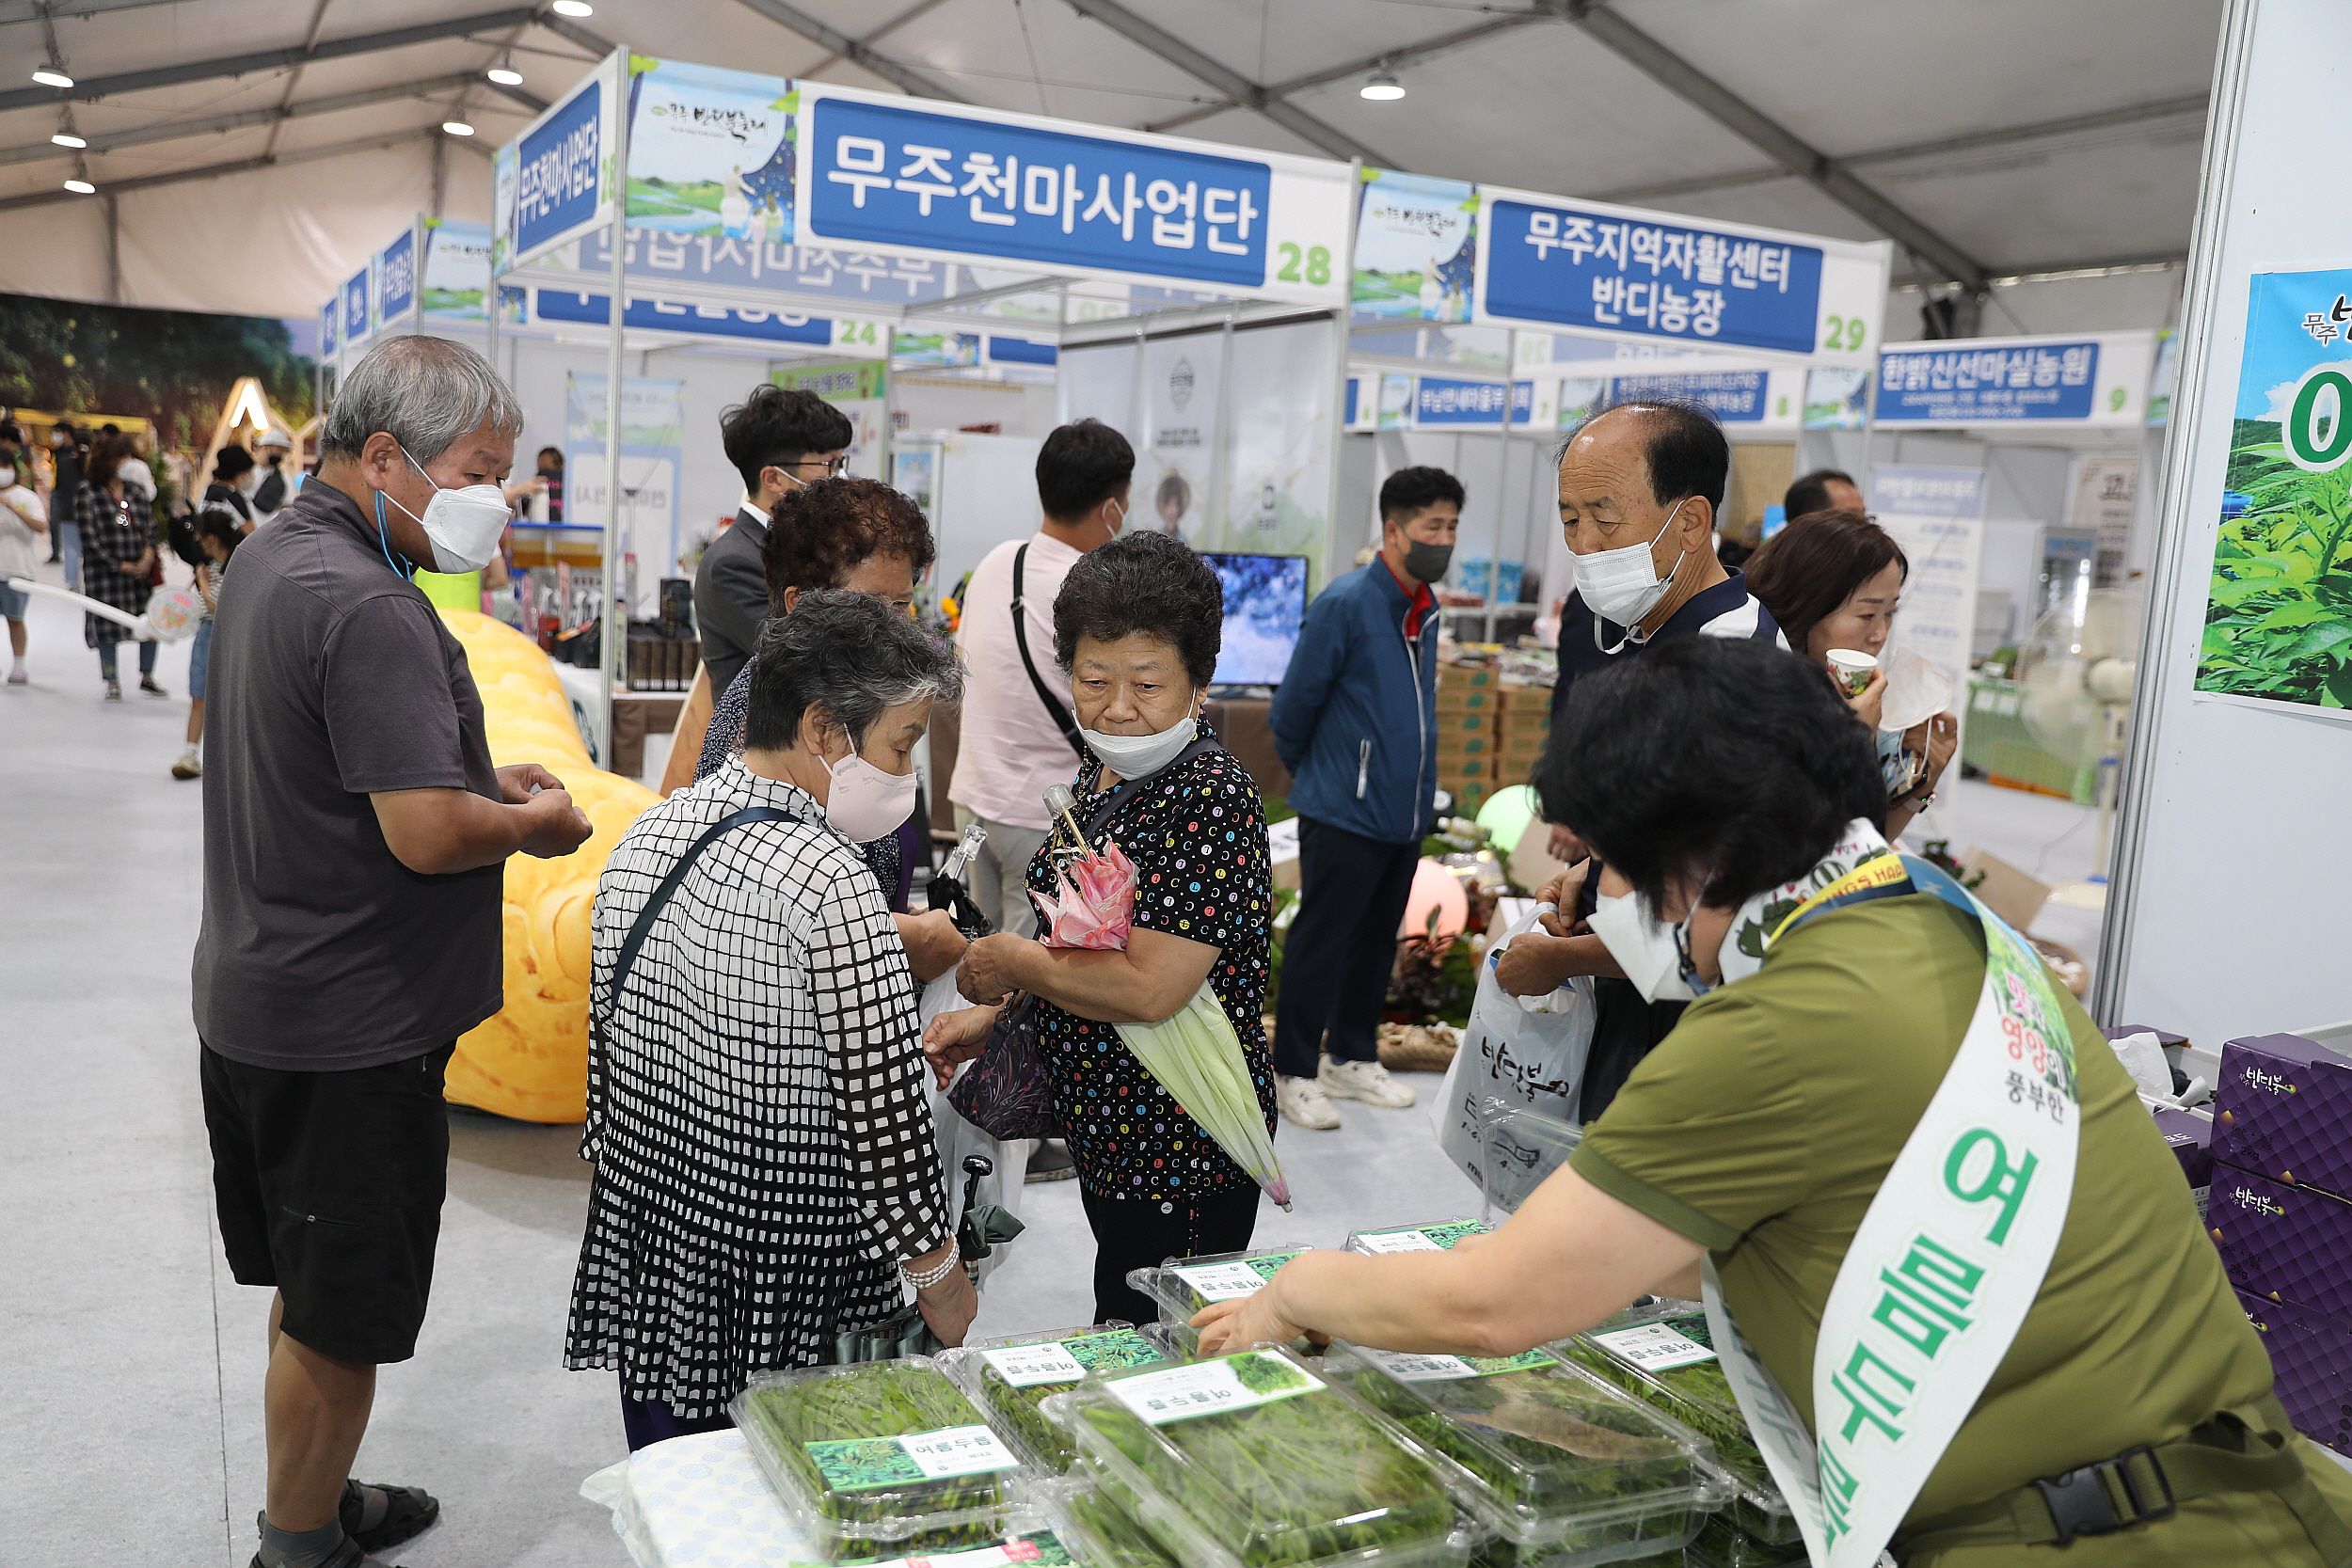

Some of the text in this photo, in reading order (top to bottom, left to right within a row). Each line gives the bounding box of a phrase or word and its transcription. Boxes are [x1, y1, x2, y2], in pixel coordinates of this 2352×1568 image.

[519, 114, 598, 228] 무주천마사업단
[826, 134, 1259, 257] 무주천마사업단
[1278, 242, 1332, 286] 28
[1524, 211, 1791, 293] 무주지역자활센터
[1592, 275, 1726, 338] 반디농장
[839, 320, 877, 346] 24
[1823, 315, 1866, 352] 29
[2303, 314, 2337, 344] 무주
[2110, 387, 2126, 412] 9
[2001, 1016, 2067, 1089] 영양이
[1482, 1037, 1562, 1101] 반딧불
[2247, 1067, 2293, 1095] 반딧불
[2005, 1069, 2064, 1125] 풍부한
[2240, 1147, 2260, 1161] 2kg
[2235, 1186, 2280, 1216] 반딧불
[1200, 1279, 1263, 1291] 여름두릅
[2229, 1264, 2249, 1280] 2kg
[1628, 1342, 1693, 1360] 여름두릅
[1007, 1361, 1073, 1374] 여름두릅
[1388, 1360, 1458, 1373] 여름두릅
[1146, 1388, 1232, 1410] 여름두릅
[915, 1435, 992, 1454] 여름두릅
